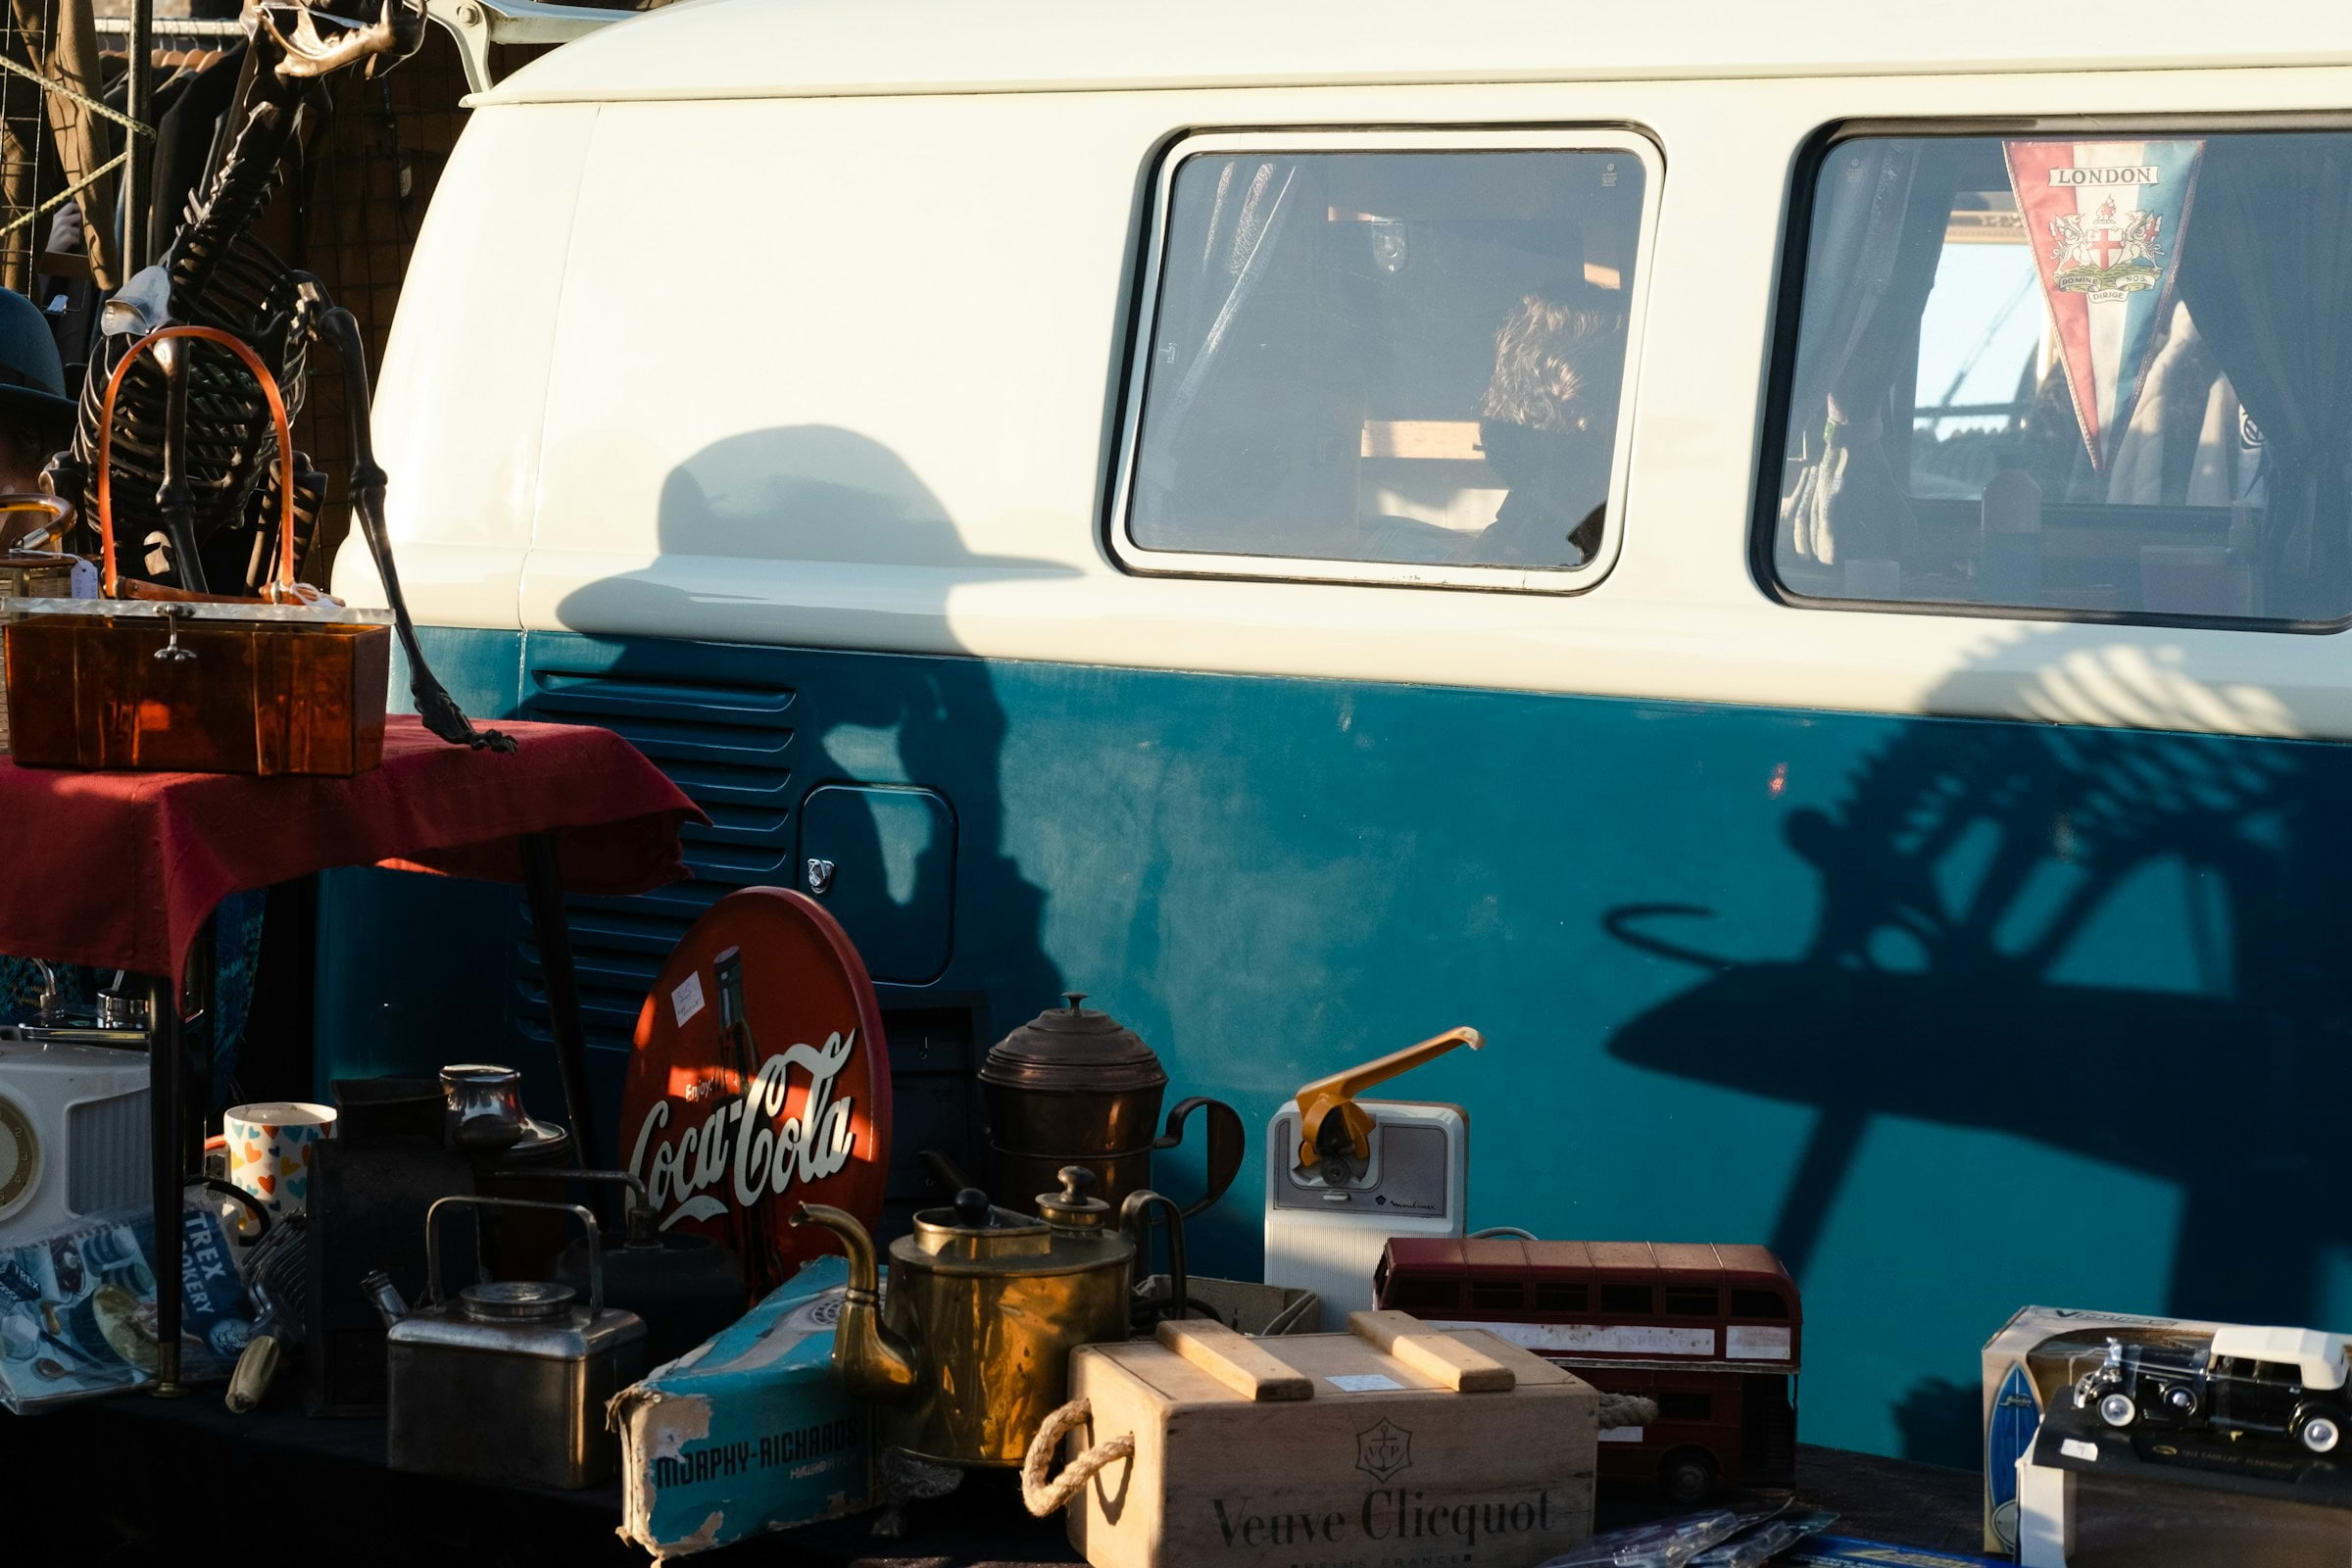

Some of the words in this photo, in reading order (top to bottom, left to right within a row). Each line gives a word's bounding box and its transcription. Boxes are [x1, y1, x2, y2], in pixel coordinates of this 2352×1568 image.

[2058, 168, 2151, 184] LONDON
[2062, 276, 2098, 286] DOMINE
[2092, 291, 2124, 301] DIRIGE
[685, 1076, 714, 1102] Enjoy!
[624, 1028, 856, 1231] Coca-Cola
[185, 1211, 226, 1280] TREX
[657, 1416, 858, 1490] MORPHY-RICHARDS
[790, 1454, 857, 1479] HAIRDRYER
[1213, 1495, 1345, 1549] Veuve
[1361, 1488, 1554, 1545] Clicquot
[1382, 1553, 1458, 1567] FRANCE
